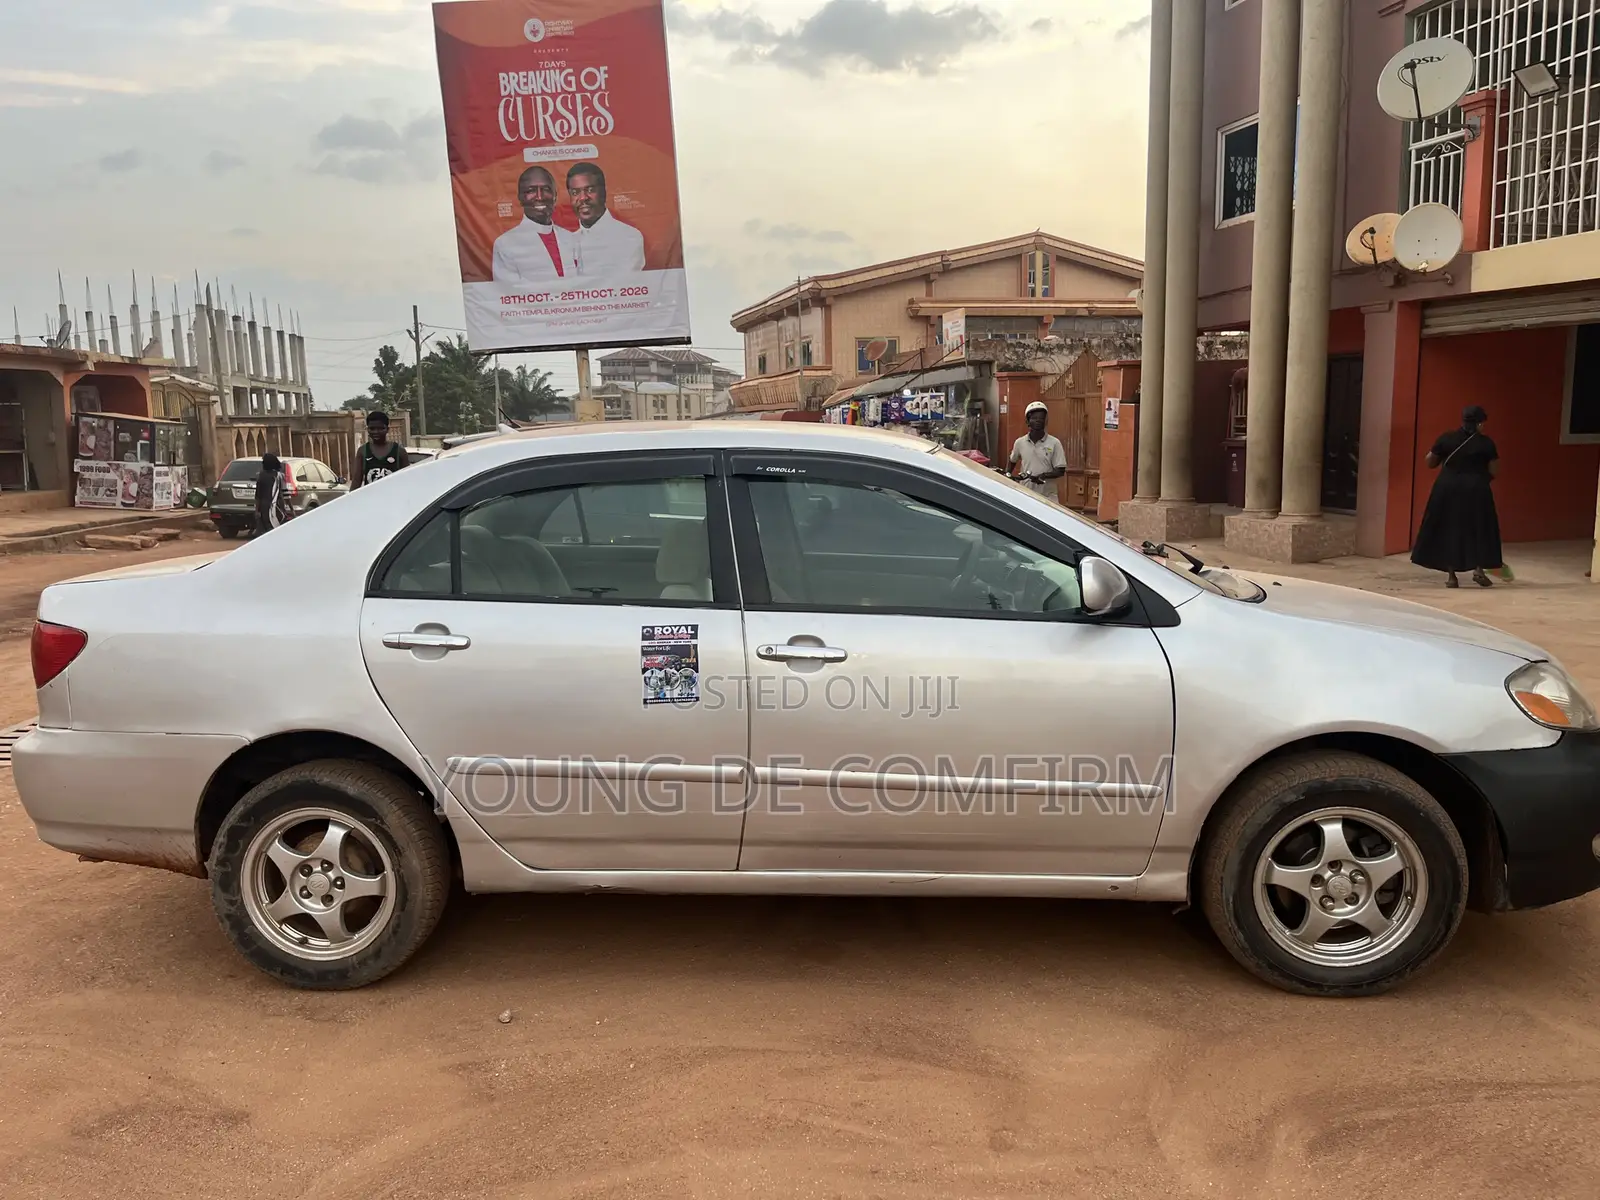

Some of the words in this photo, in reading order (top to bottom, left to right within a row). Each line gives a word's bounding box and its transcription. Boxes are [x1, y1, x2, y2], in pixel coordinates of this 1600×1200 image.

[544, 60, 567, 68] DAYS
[498, 69, 577, 97] BREAKING
[580, 66, 609, 91] OF
[498, 91, 615, 142] CURSES
[500, 295, 526, 305] 18TH
[527, 293, 554, 303] OCT.
[560, 291, 590, 301] 25TH
[591, 288, 617, 299] OCT.
[620, 286, 649, 297] 2026
[500, 310, 522, 318] FAITH
[581, 304, 607, 313] BEHIND
[620, 301, 650, 310] MARKET
[654, 626, 695, 635] ROYAL
